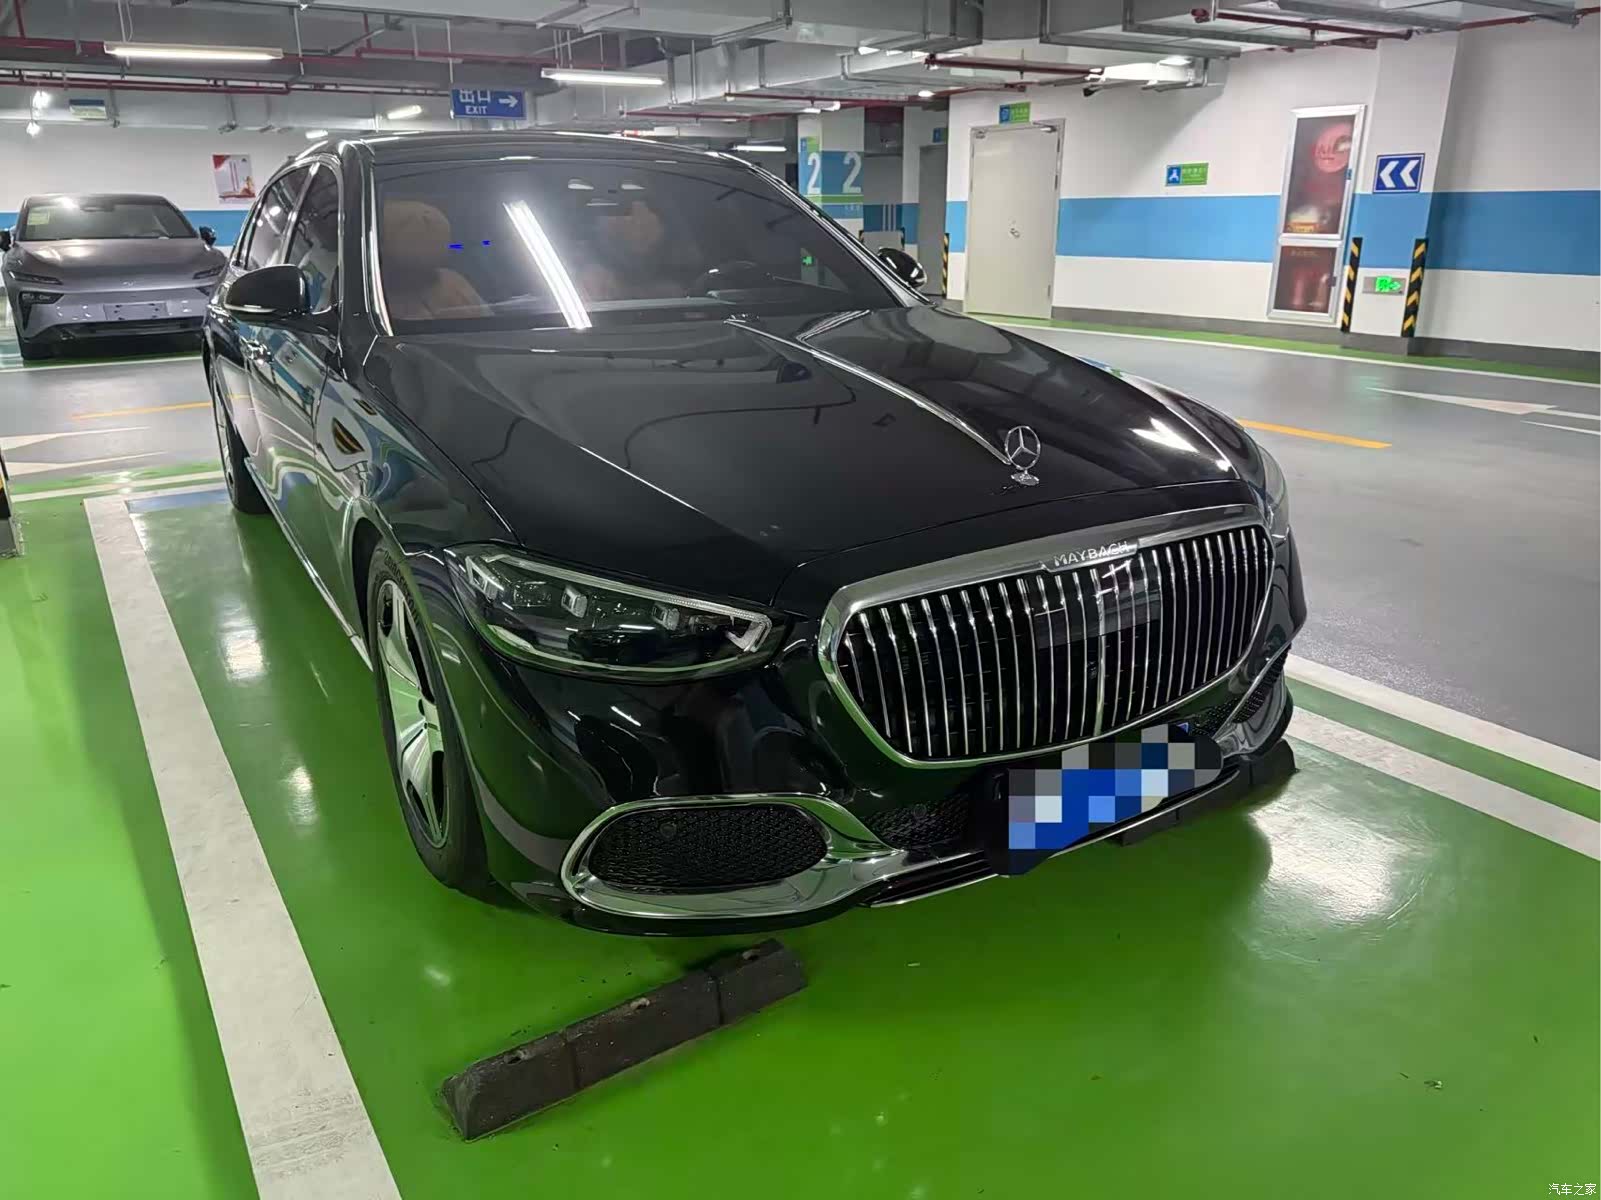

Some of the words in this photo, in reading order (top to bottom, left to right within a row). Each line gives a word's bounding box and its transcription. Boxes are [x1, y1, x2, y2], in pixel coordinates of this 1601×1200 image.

[465, 105, 487, 114] EXIT
[807, 152, 821, 194] 2
[842, 151, 862, 194] 2
[1054, 540, 1130, 567] MAYBACH
